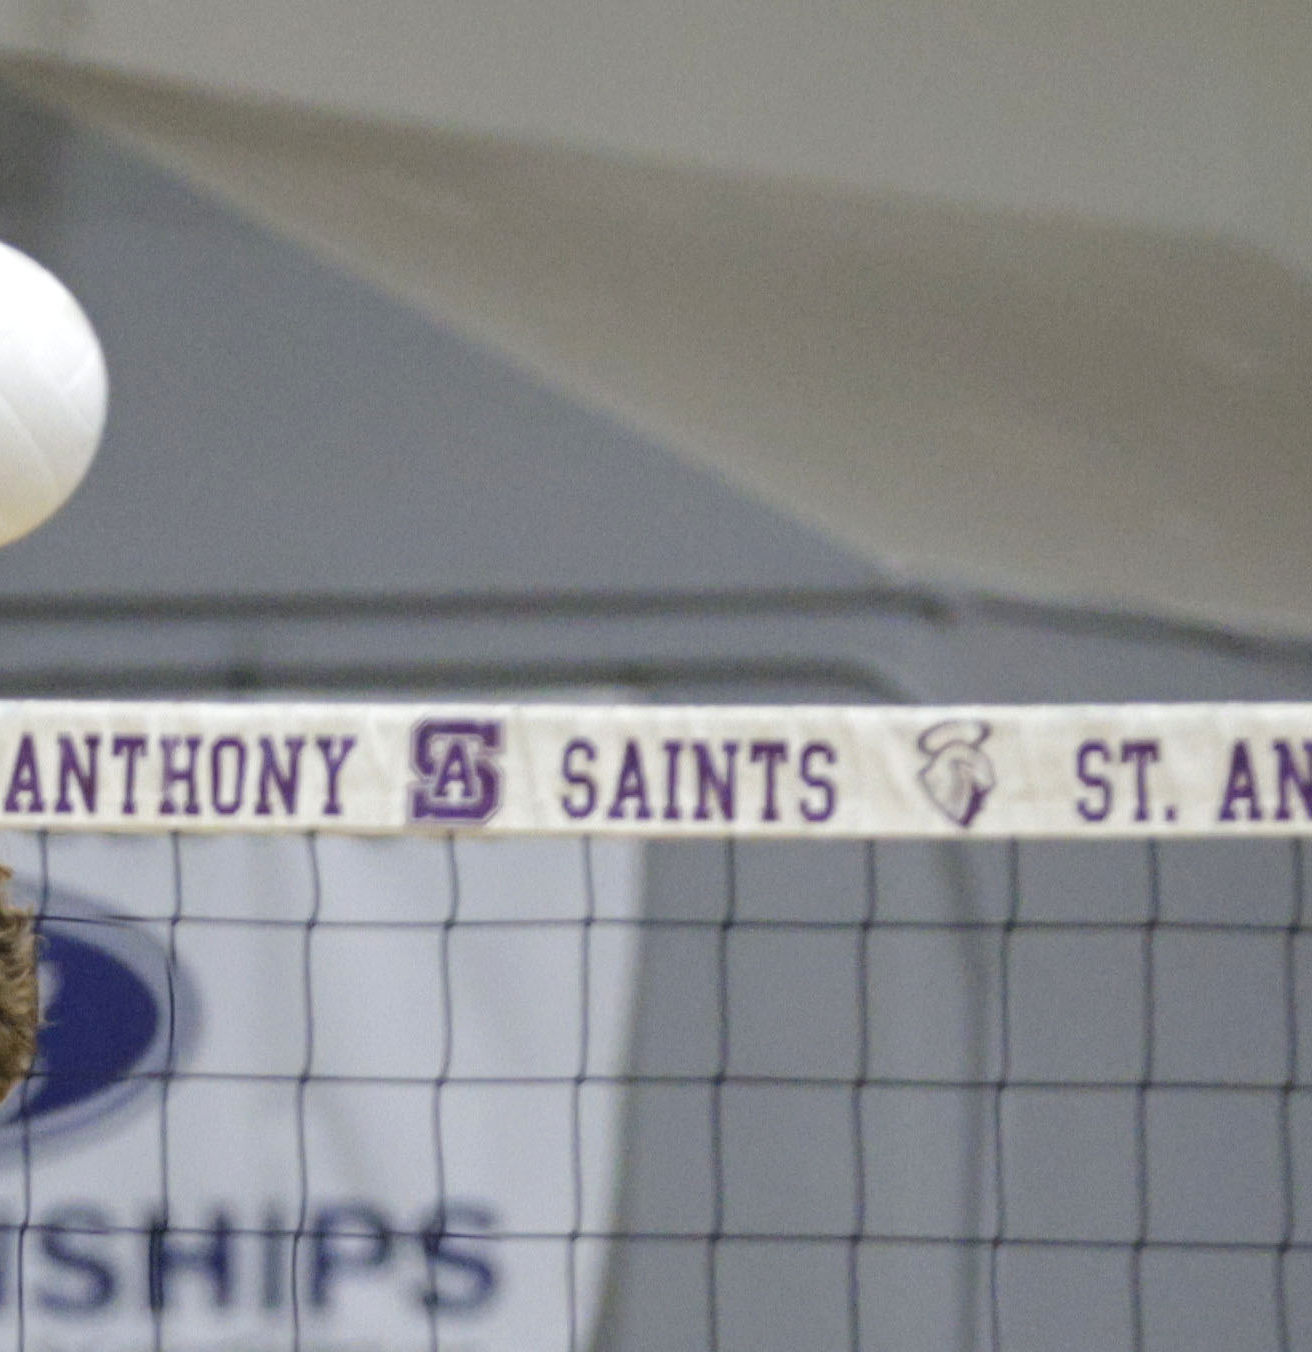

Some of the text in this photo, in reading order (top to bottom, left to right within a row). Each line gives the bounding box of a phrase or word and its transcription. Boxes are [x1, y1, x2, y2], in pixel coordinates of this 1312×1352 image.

[4, 734, 355, 816] ANTHONY
[562, 739, 836, 822] SAINTS
[1077, 739, 1177, 822] ST.
